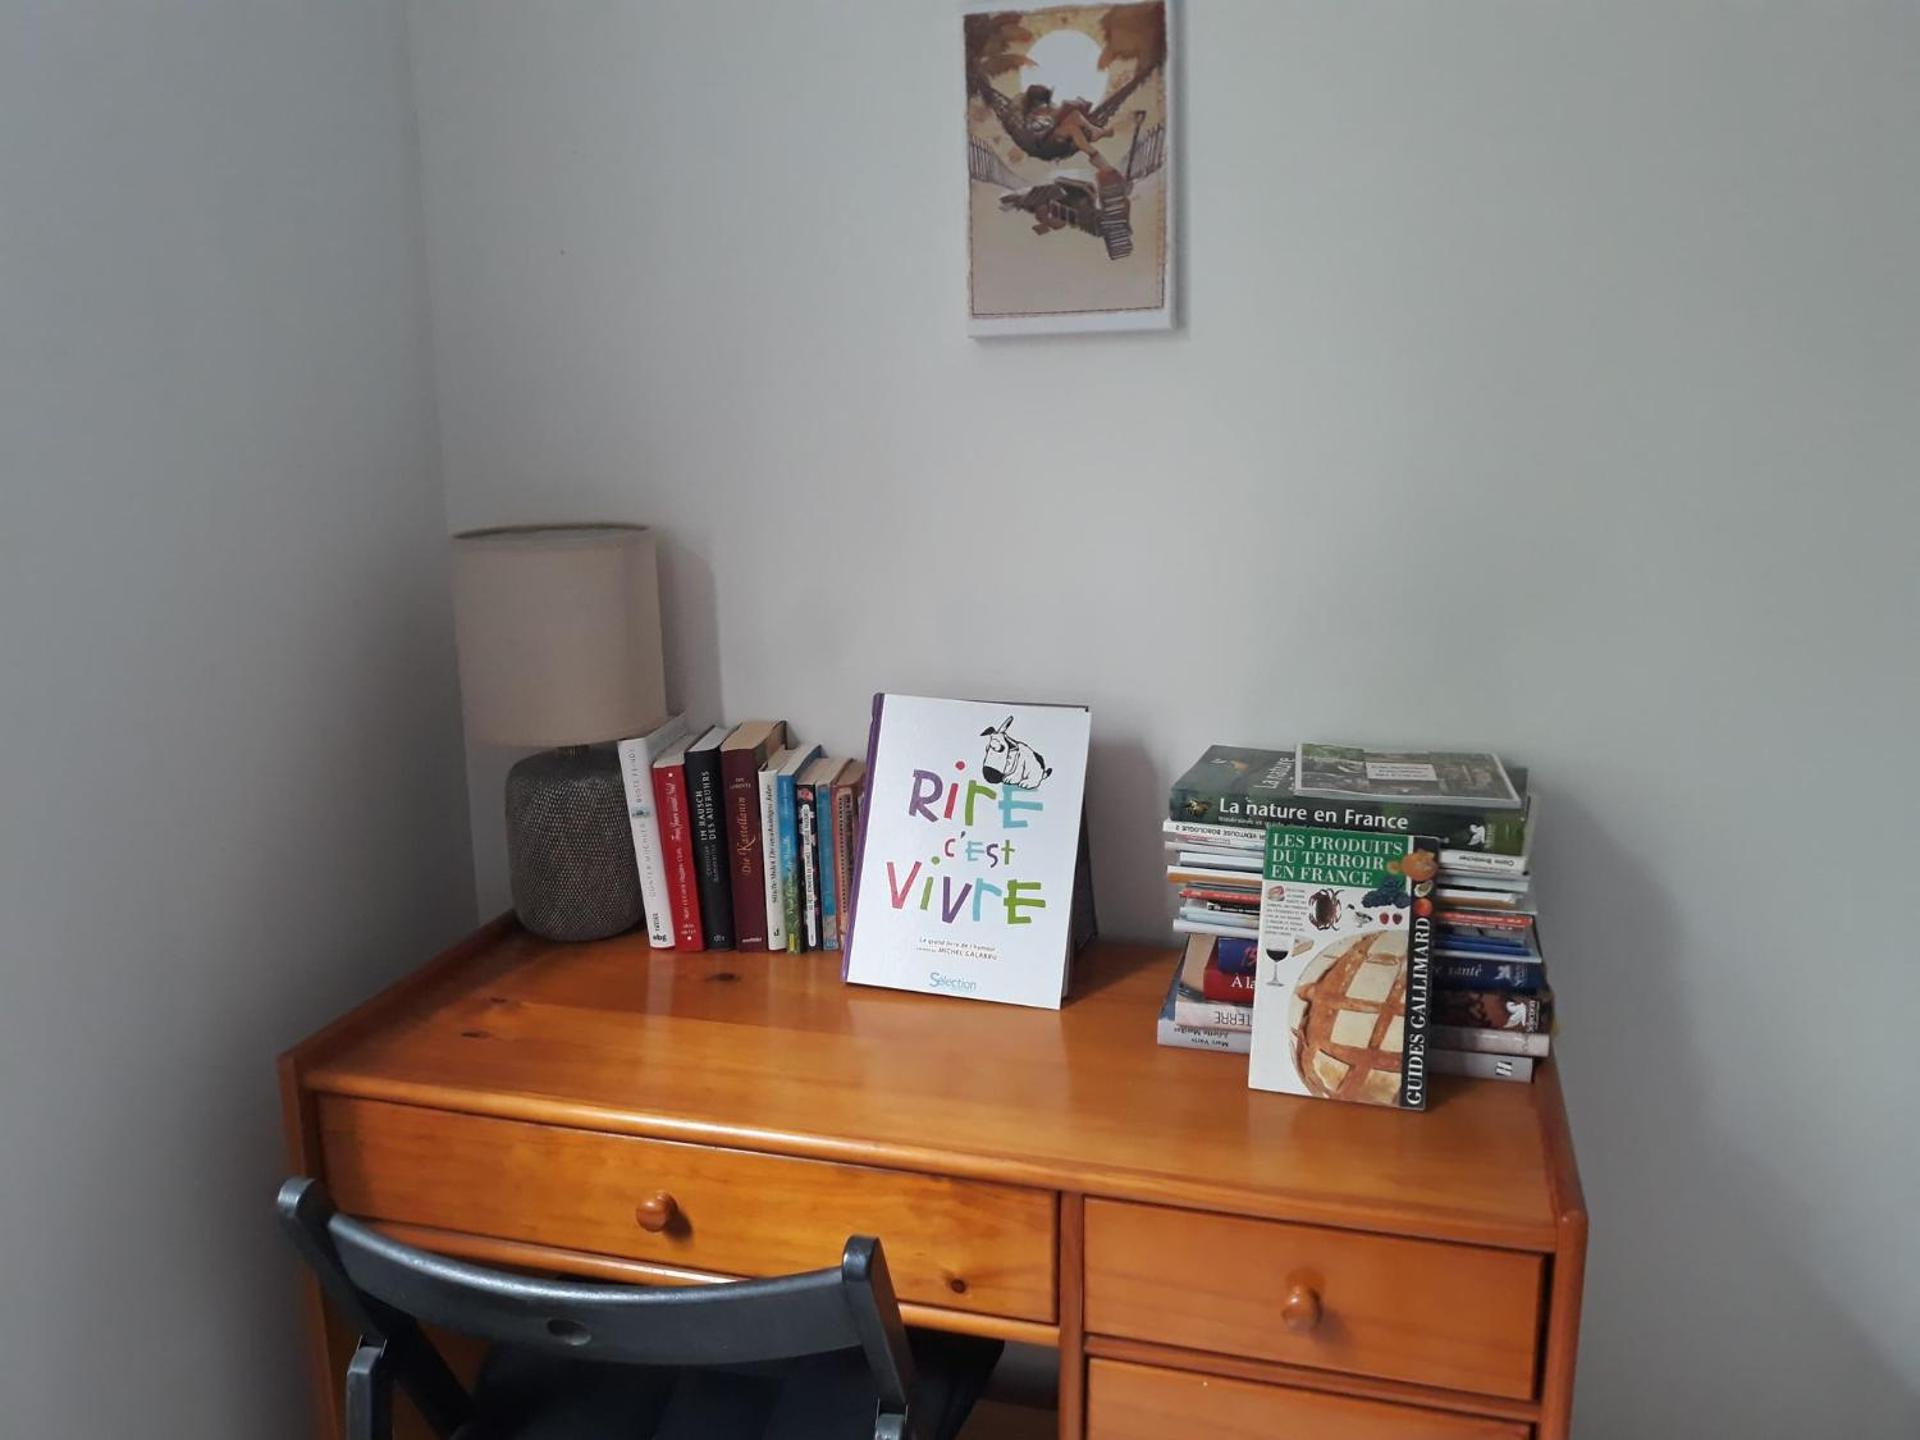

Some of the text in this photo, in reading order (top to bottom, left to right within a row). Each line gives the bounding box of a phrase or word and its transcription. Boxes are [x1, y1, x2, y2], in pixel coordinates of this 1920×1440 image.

[696, 790, 708, 841] IM RAUSCH
[701, 770, 717, 840] DES AUFRUHRS
[1219, 798, 1409, 830] La nature en France
[1273, 833, 1403, 856] LES PRODUITS
[741, 857, 750, 874] Die
[1272, 849, 1385, 871] DU TERROIR
[1271, 865, 1373, 886] EN FRANCE
[1448, 963, 1484, 977] santé
[1407, 917, 1431, 1105] GUIDES GALLIMARD
